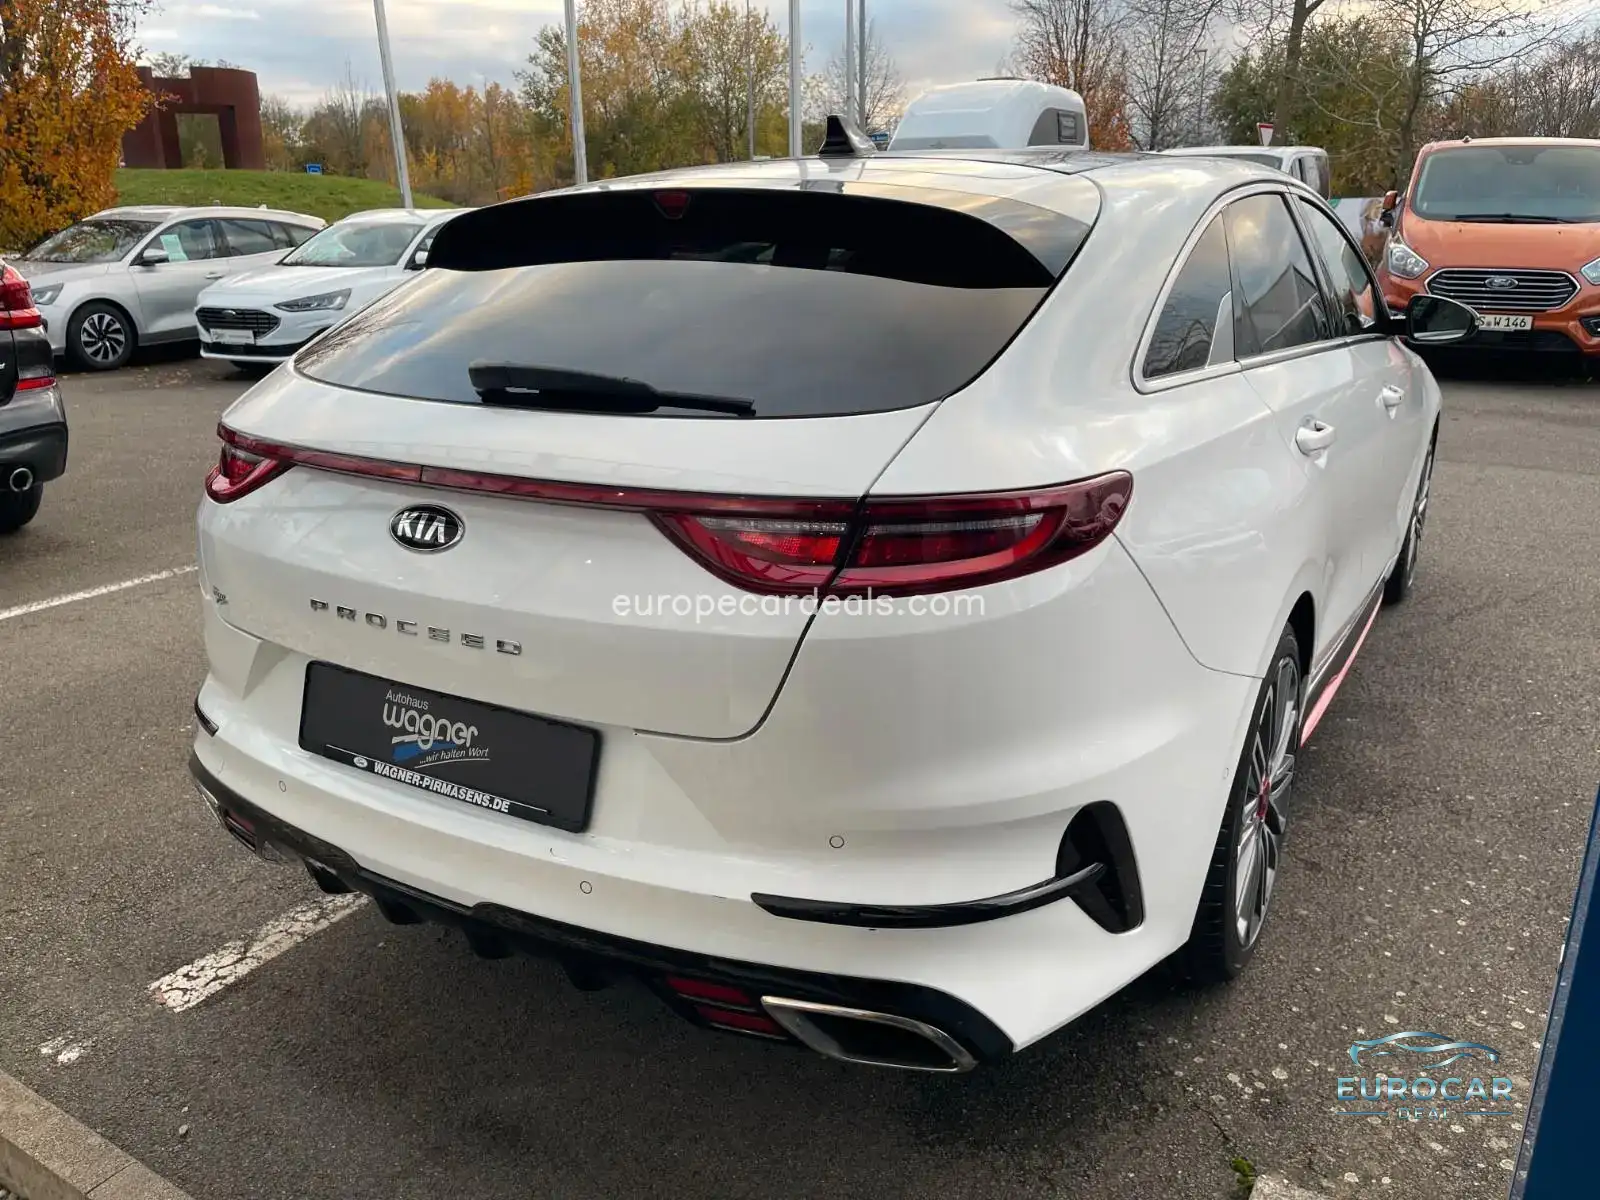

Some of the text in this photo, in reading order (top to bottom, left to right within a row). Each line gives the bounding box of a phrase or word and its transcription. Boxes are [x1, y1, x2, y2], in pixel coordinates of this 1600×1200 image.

[1504, 317, 1527, 328] 146
[397, 511, 446, 543] KIA
[309, 598, 523, 656] PROCEED
[385, 688, 429, 711] Autohaus
[382, 702, 479, 750] wagner
[440, 747, 466, 760] halten
[468, 746, 489, 758] Wort
[373, 761, 510, 813] WAGNER-PIRMASENS.DE
